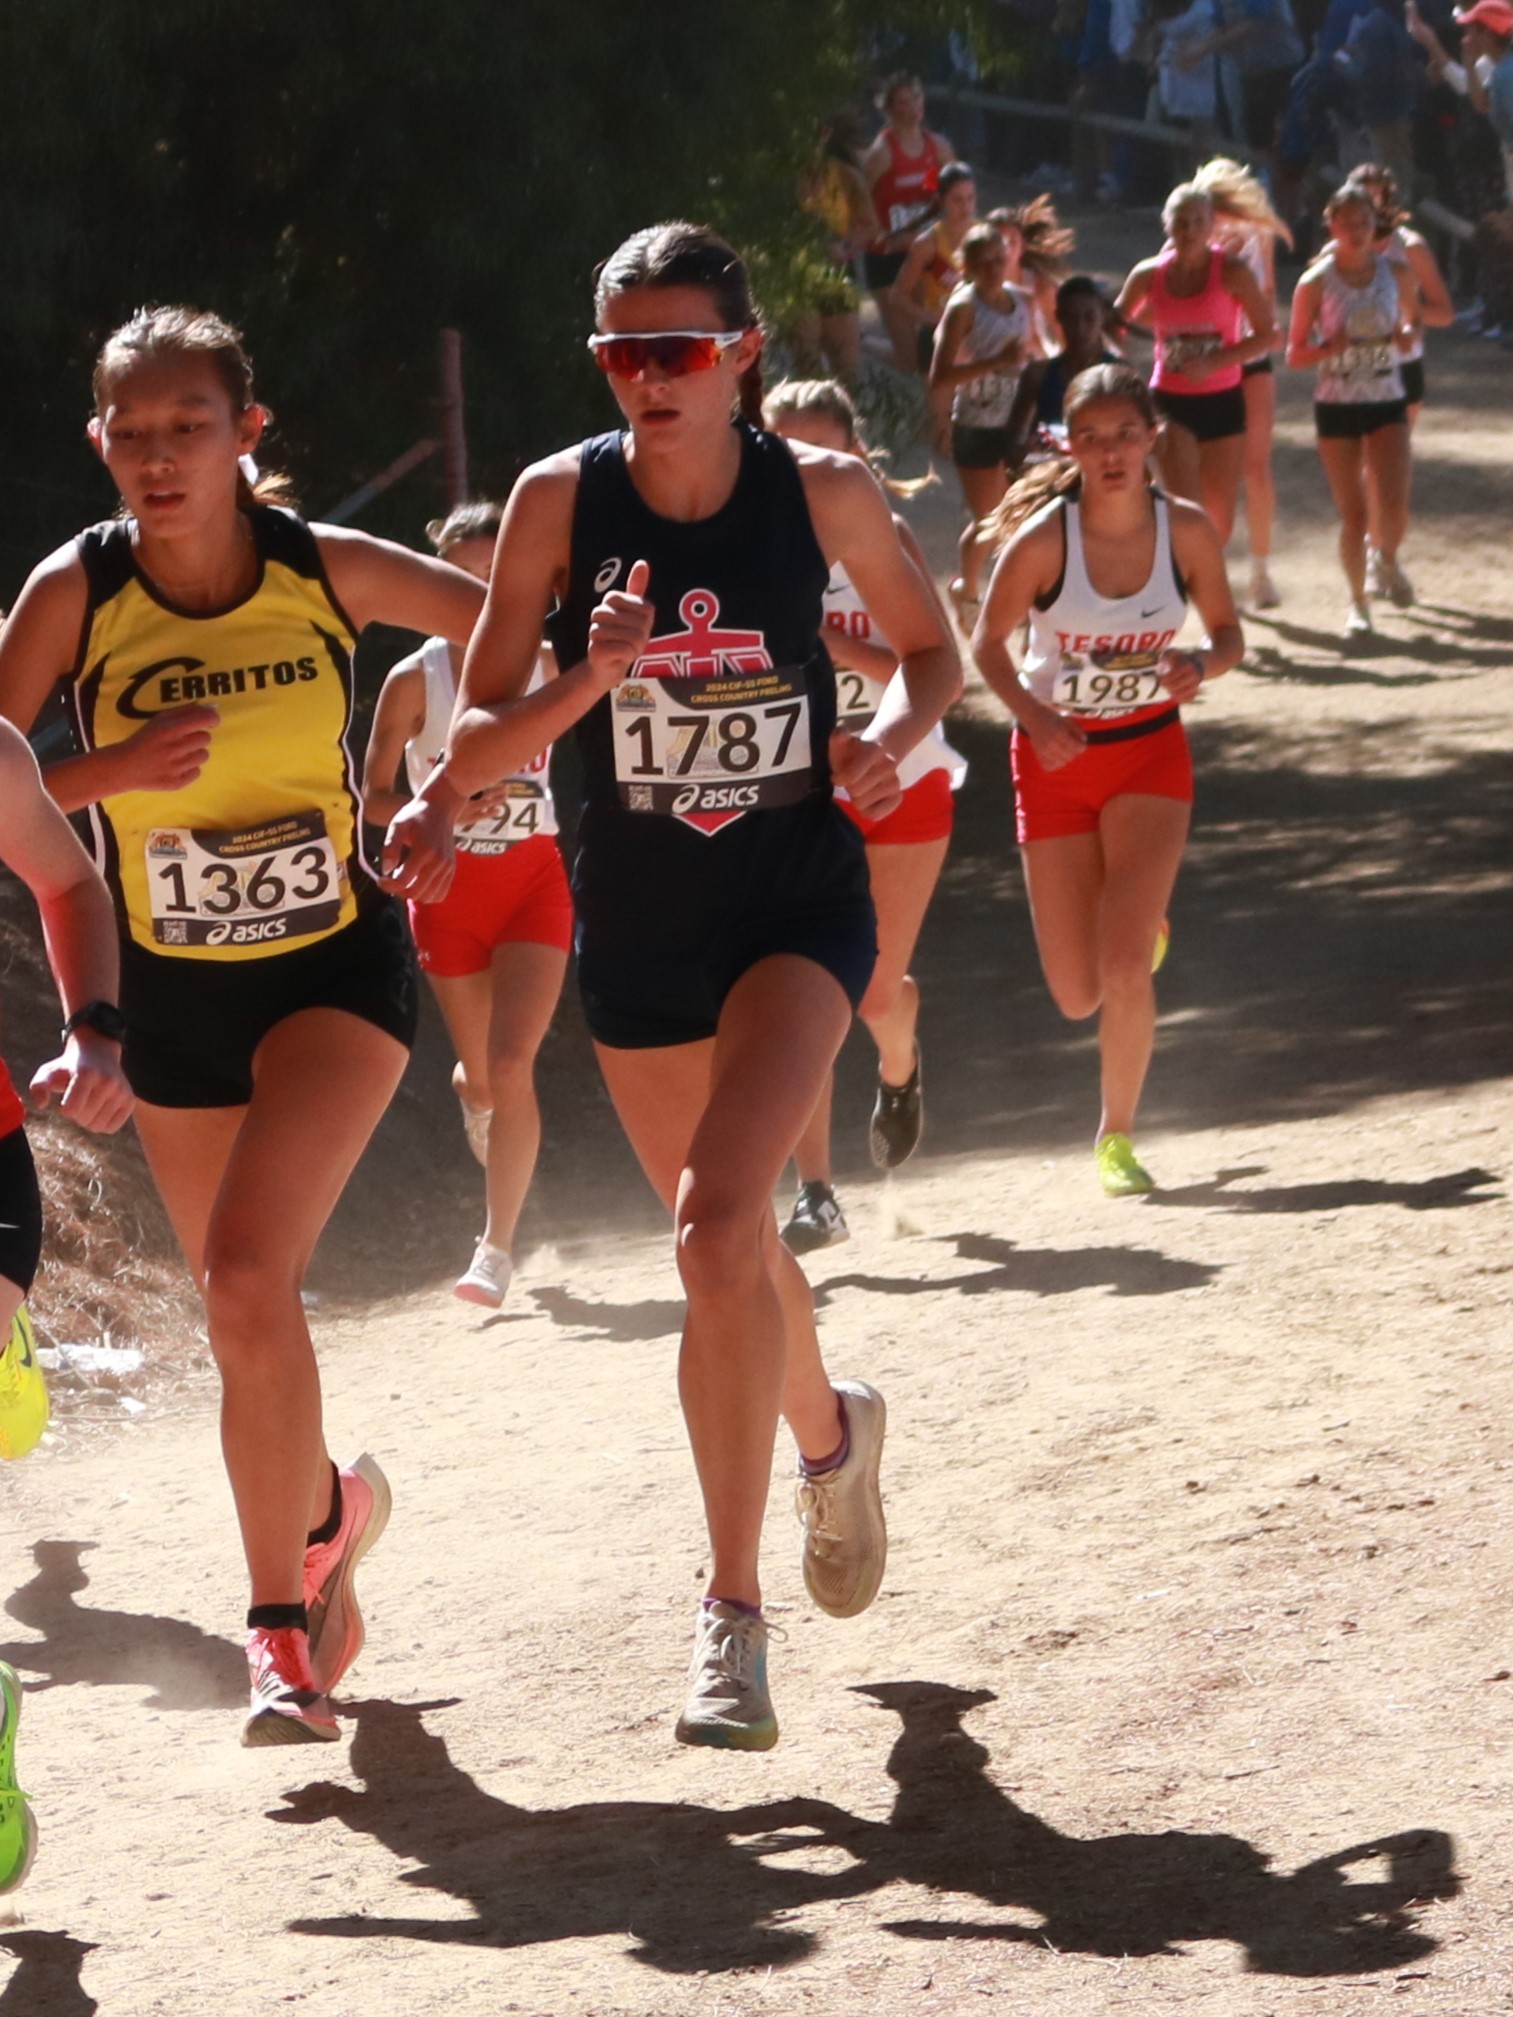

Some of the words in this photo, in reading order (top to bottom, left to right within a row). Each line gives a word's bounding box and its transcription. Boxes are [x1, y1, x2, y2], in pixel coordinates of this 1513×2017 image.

[116, 656, 318, 719] CERRITOS
[691, 694, 718, 704] CROSS
[720, 689, 758, 702] COUNTRY
[1062, 671, 1161, 704] 1987
[625, 702, 802, 776] 1787
[462, 801, 539, 834] 94
[219, 843, 245, 853] CROSS
[246, 836, 281, 851] COUNTRY
[158, 846, 330, 915] 1363
